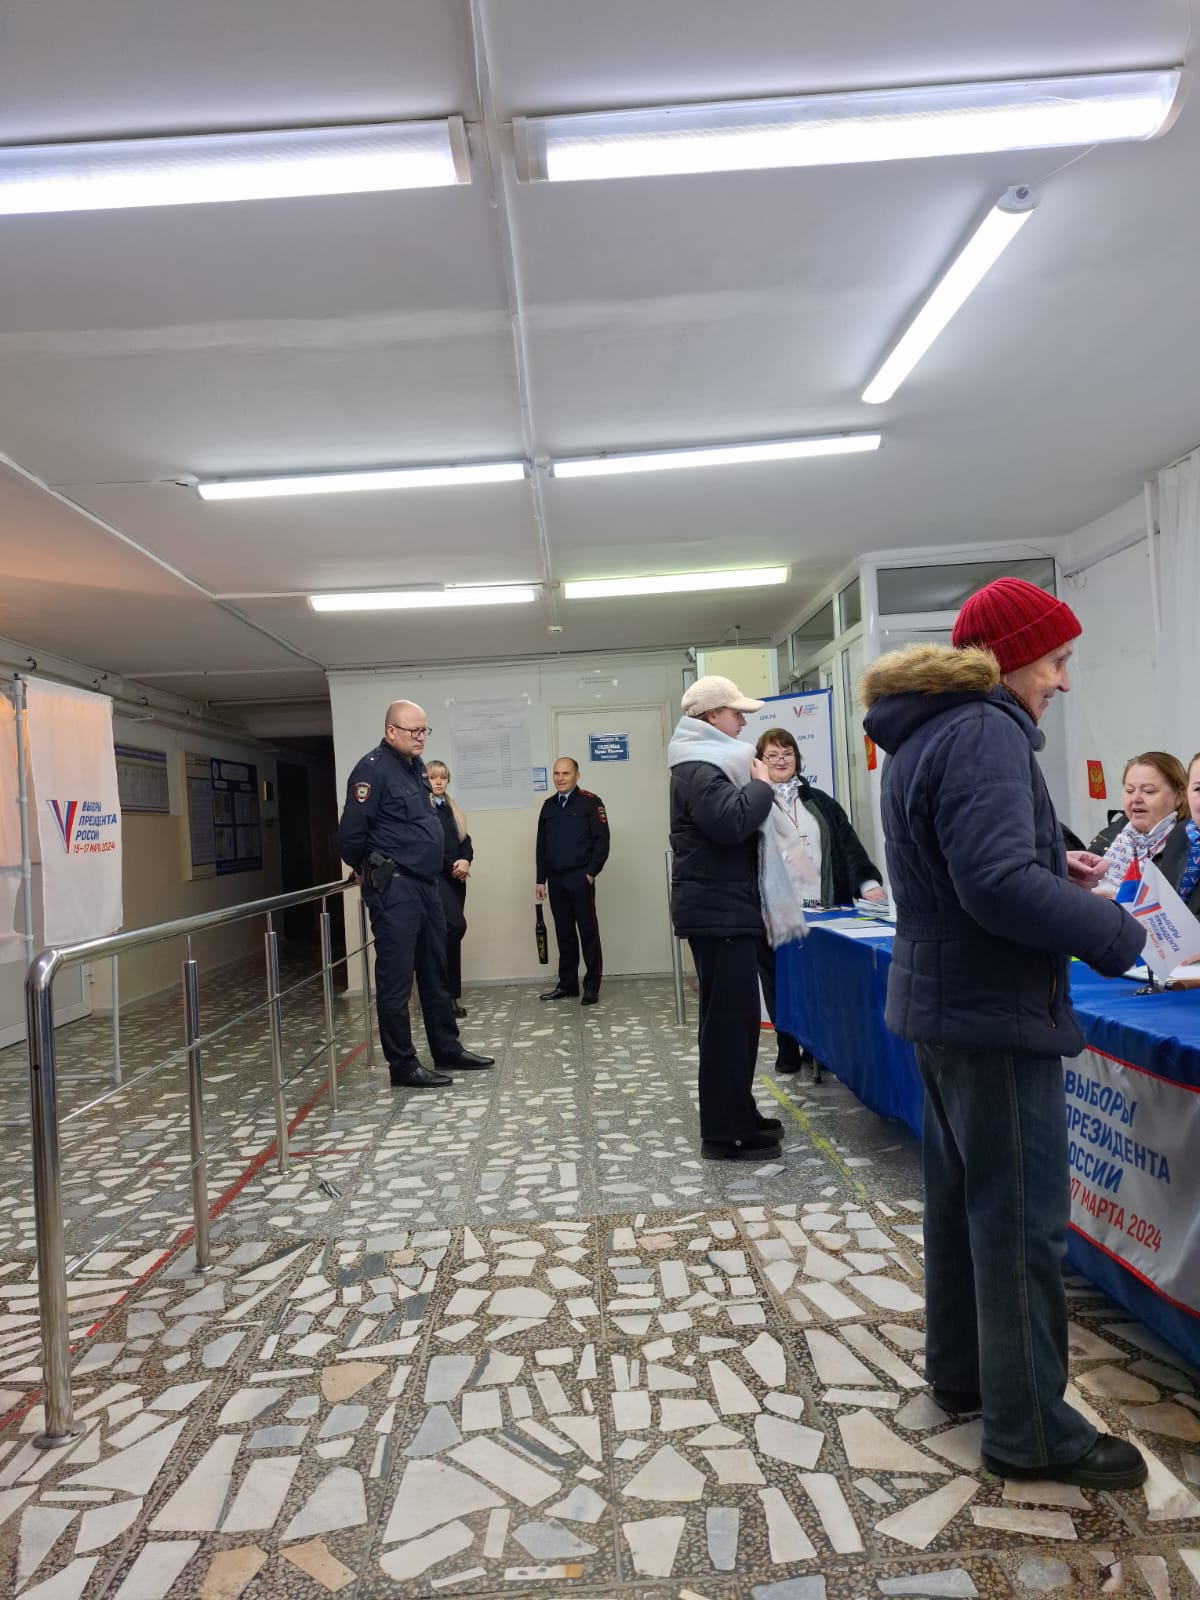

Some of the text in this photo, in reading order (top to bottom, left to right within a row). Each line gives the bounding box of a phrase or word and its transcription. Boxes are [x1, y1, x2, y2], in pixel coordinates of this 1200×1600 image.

[1064, 1069, 1137, 1128] ВЫБОРЫ
[1068, 1141, 1124, 1194] ОССИИ
[1081, 1185, 1125, 1230] МАРТА
[1126, 1213, 1163, 1253] 2024
